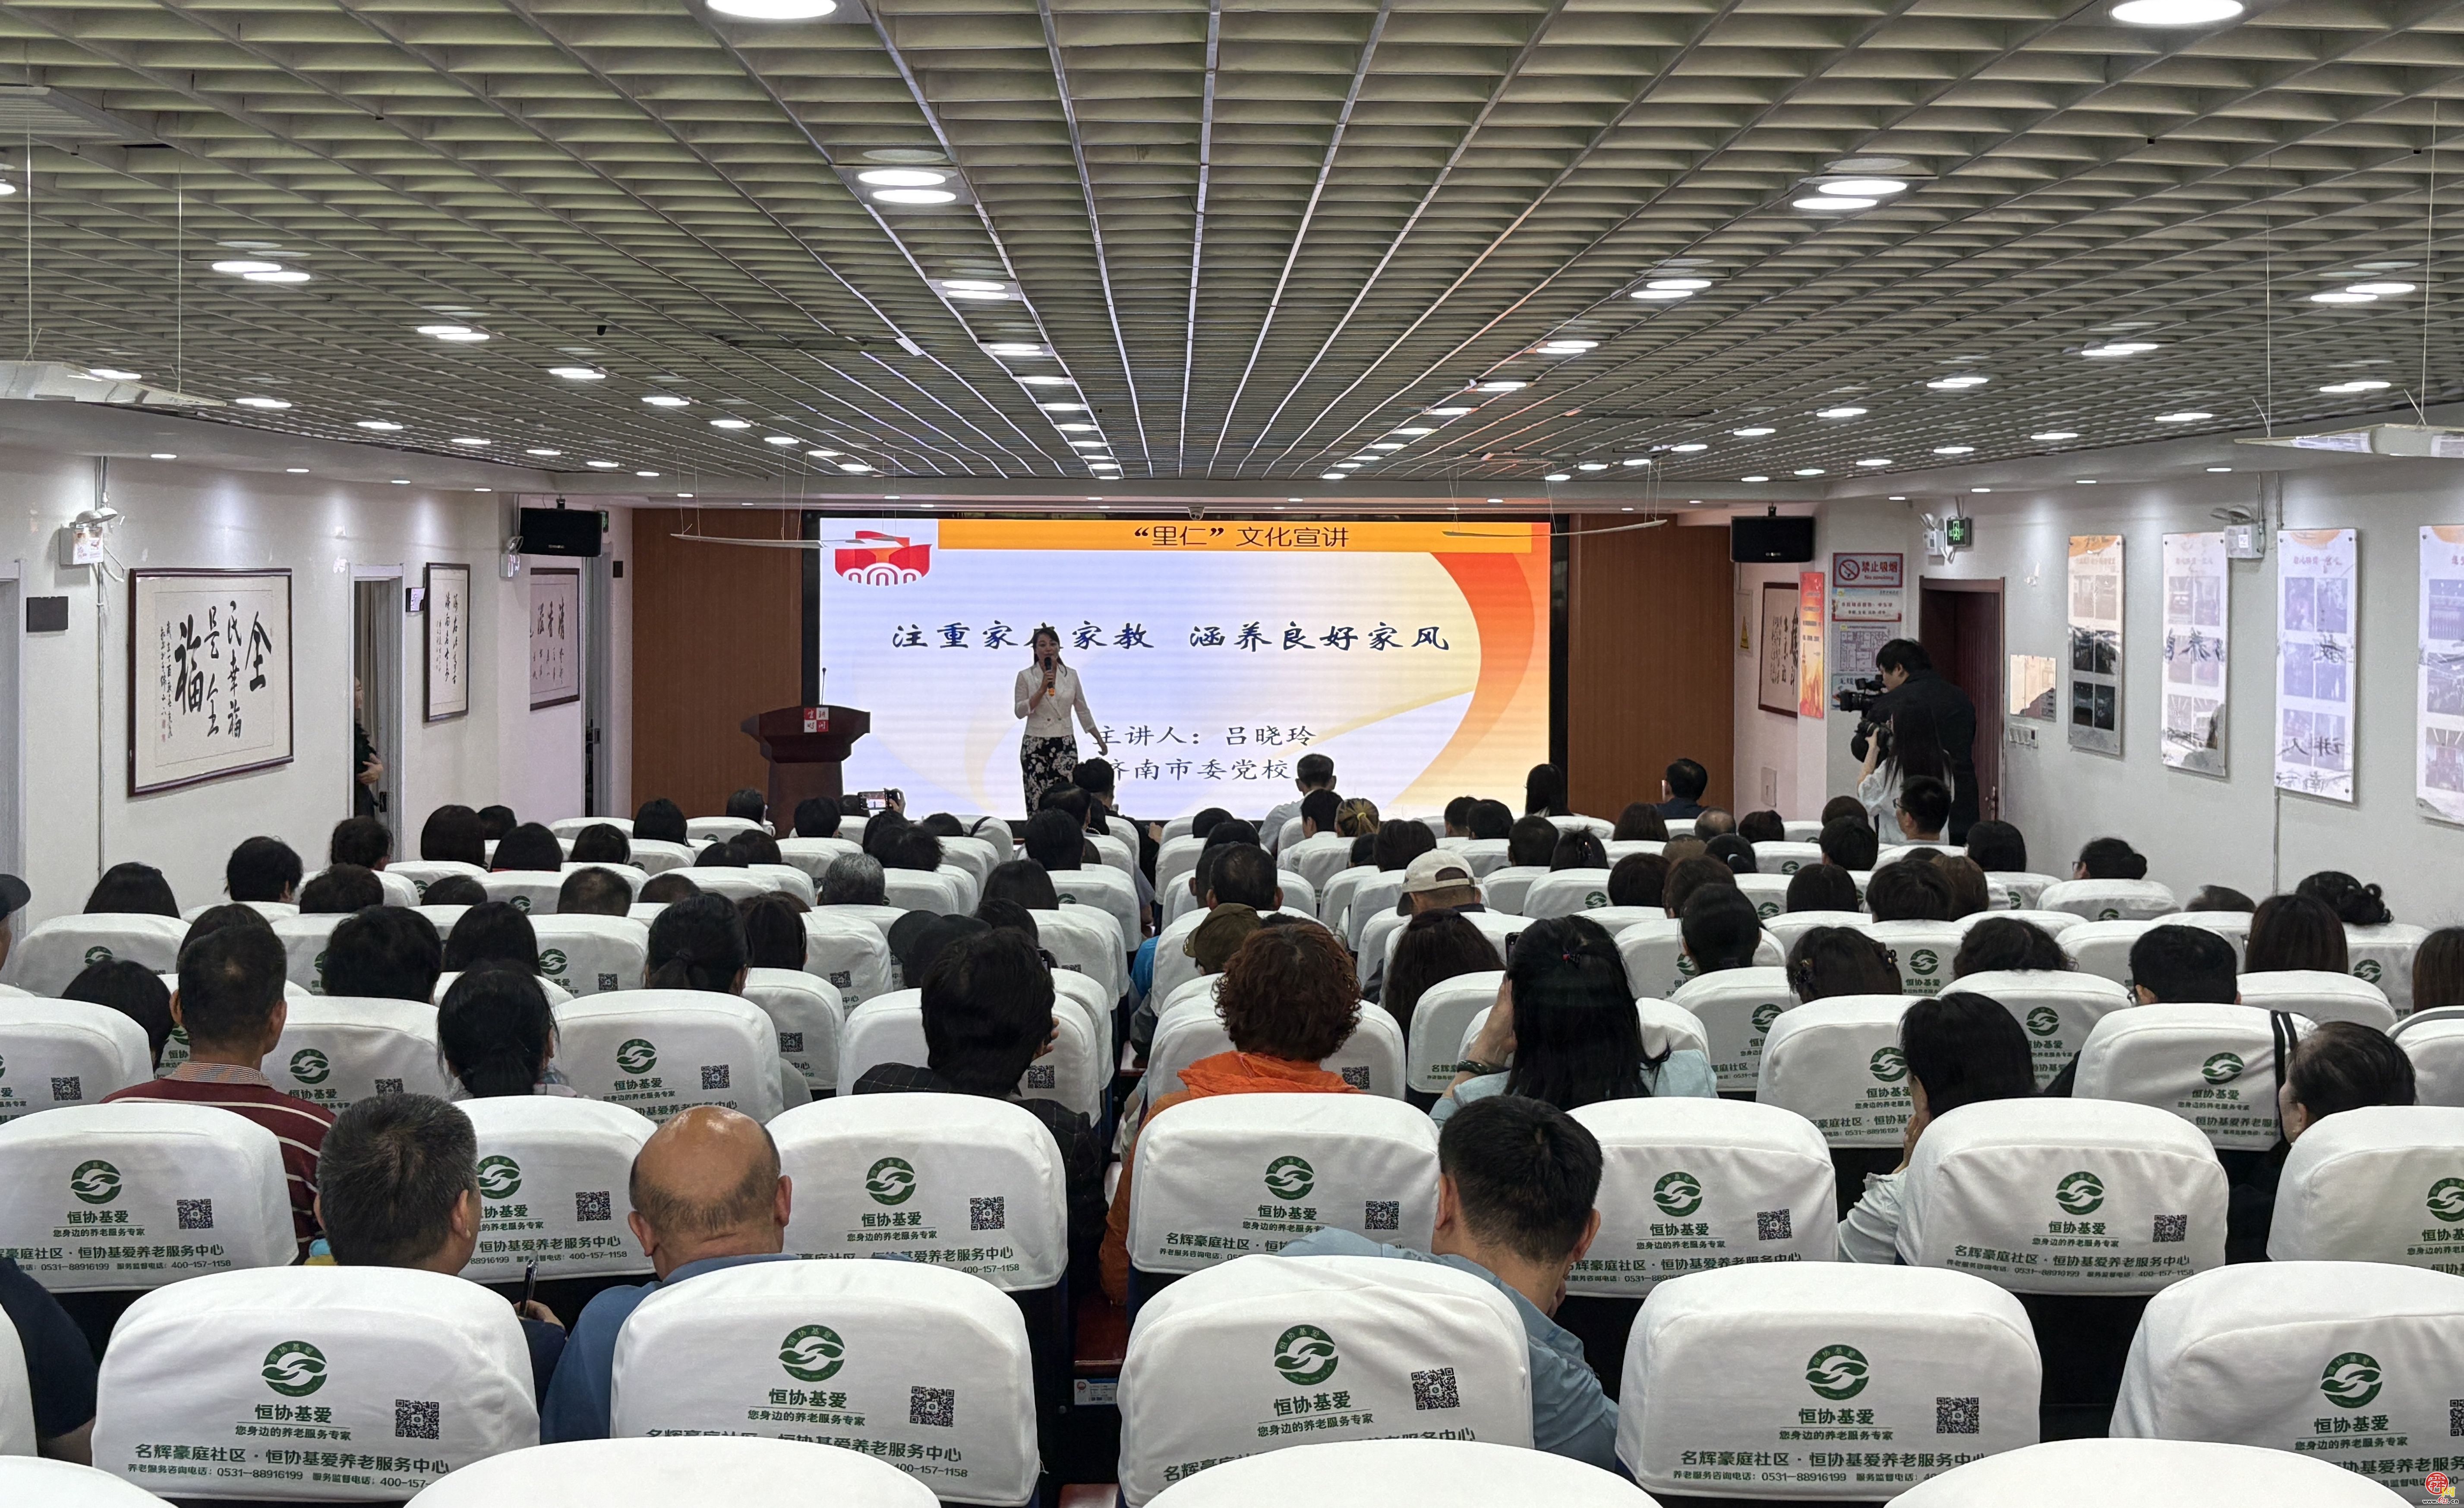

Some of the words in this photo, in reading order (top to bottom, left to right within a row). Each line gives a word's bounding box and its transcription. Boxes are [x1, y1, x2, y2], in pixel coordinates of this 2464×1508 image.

[1134, 525, 1224, 546] “里仁”
[1236, 526, 1350, 547] 文化宣讲
[1861, 560, 1898, 573] 禁止吸烟
[1190, 621, 1451, 653] 涵养良好家风
[174, 613, 204, 715] 福
[1225, 725, 1318, 746] 吕晓玲
[614, 1077, 663, 1091] 恒协基爱
[2192, 1088, 2240, 1100] 恒协基爱
[67, 1210, 129, 1224] 恒协基爱
[480, 1204, 528, 1218] 协基爱
[1257, 1205, 1317, 1221] 恒协基爱
[861, 1211, 922, 1228] 恒协基爱
[1242, 1221, 1325, 1233] 您身边的养老服务专
[847, 1230, 937, 1242] 您身边的养老服务专家
[1650, 1223, 1710, 1236] 恒协基爱
[2048, 1221, 2106, 1235] 恒协基爱
[1636, 1240, 1726, 1250] 您身边的养老服务专家
[768, 1388, 848, 1409] 恒协基爱
[1273, 1390, 1353, 1417] 恒协基爱
[255, 1404, 332, 1424] 恒协基爱
[747, 1410, 866, 1427] 您身边的养老服务专家
[1798, 1408, 1874, 1426] 恒协基爱
[1257, 1413, 1374, 1438] 您身边的养老服务专家
[2314, 1414, 2389, 1435] 恒协基爱
[235, 1425, 352, 1442] 您身边的养老服务专家
[1779, 1430, 1894, 1441] 您身边的养老服务专家
[2295, 1436, 2408, 1451] 您身边的养老服务专家
